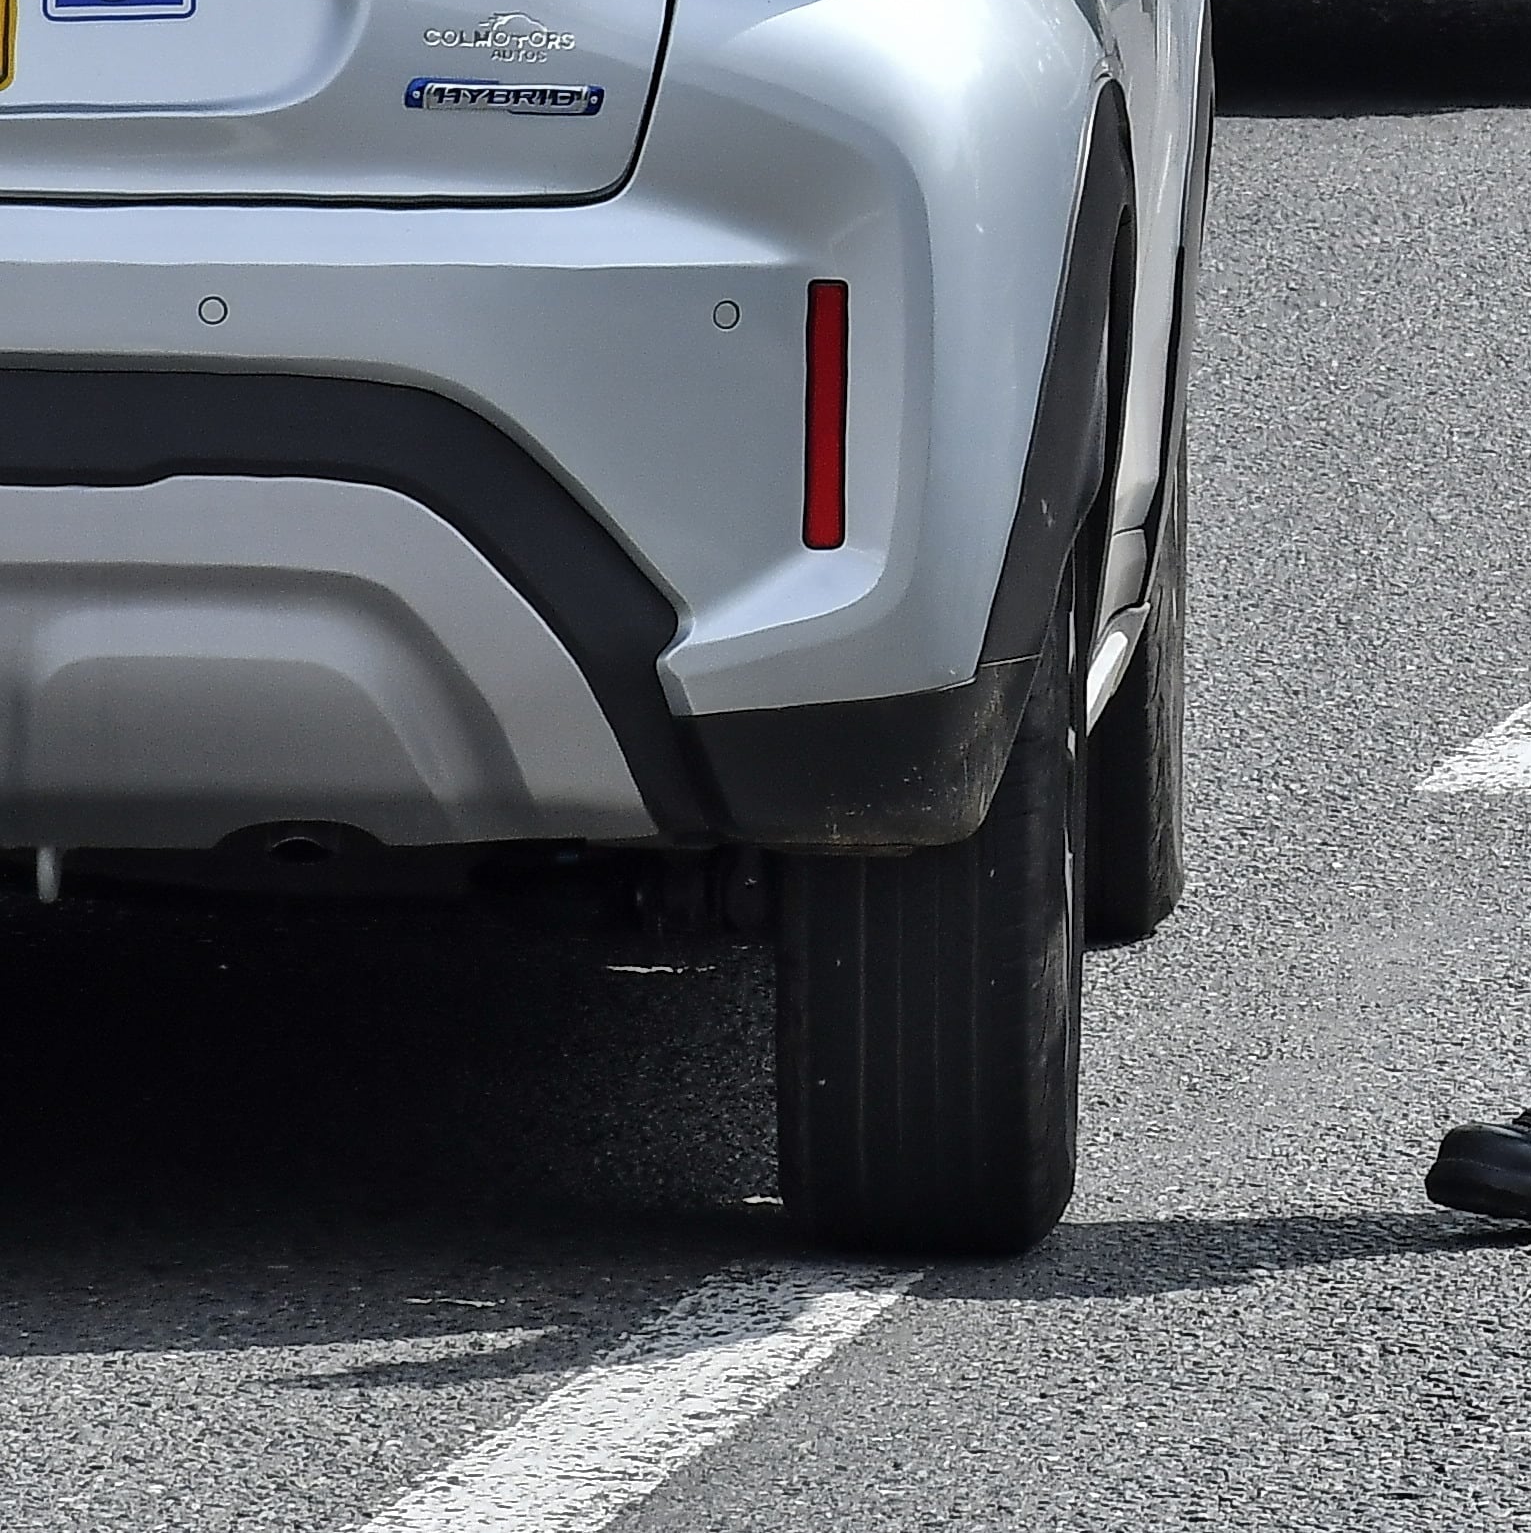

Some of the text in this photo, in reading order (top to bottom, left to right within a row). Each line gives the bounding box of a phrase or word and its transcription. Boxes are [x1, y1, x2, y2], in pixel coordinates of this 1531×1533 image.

[423, 28, 576, 50] COLMOTORS
[491, 49, 548, 63] AUTOS
[433, 86, 578, 107] HYBRID
